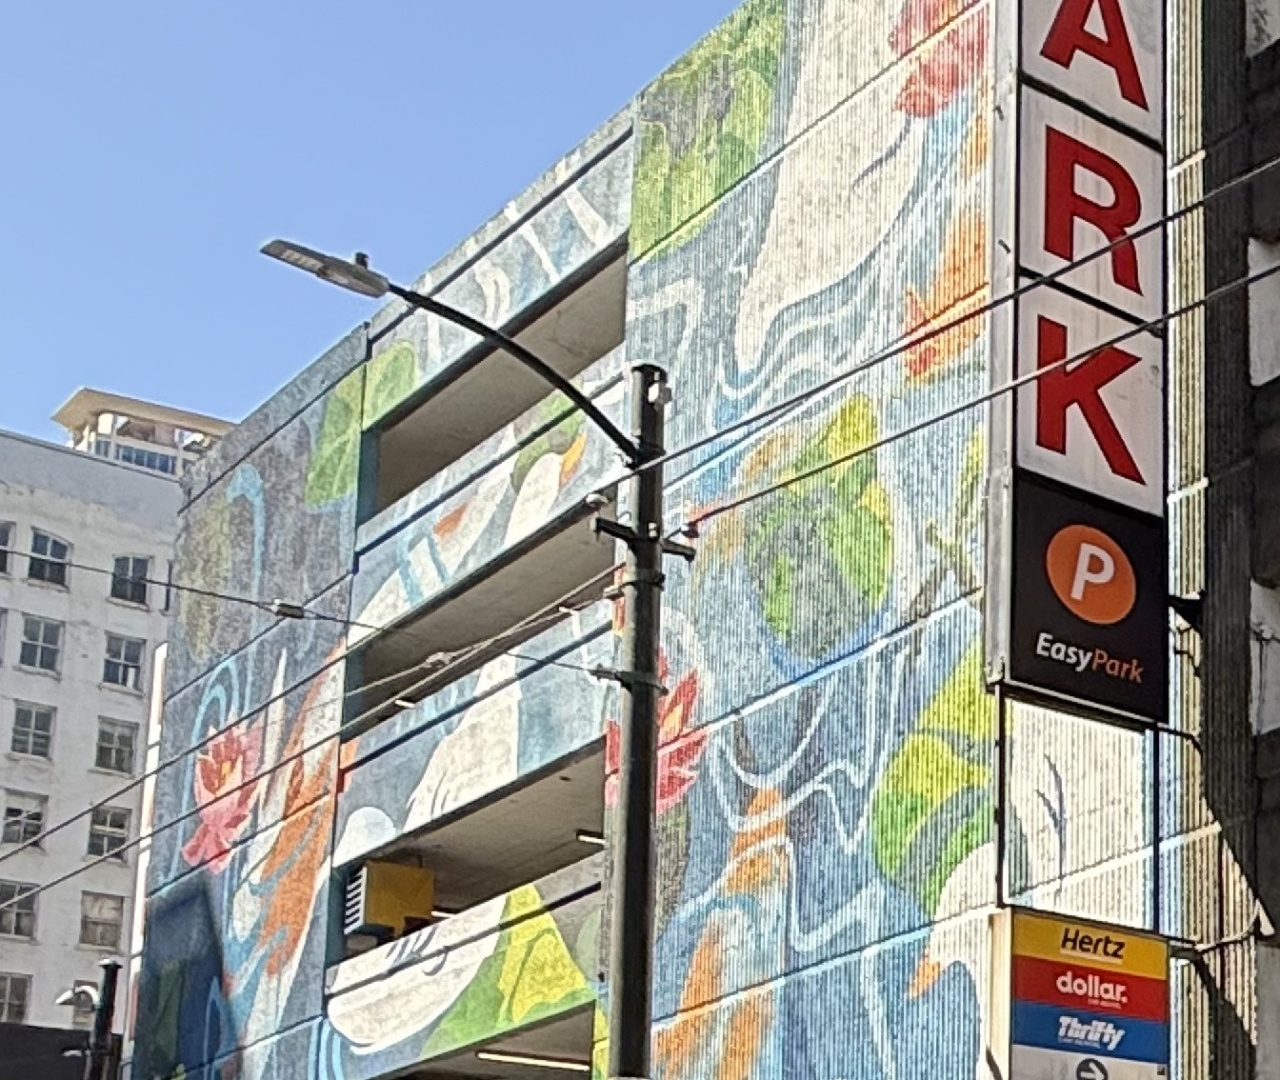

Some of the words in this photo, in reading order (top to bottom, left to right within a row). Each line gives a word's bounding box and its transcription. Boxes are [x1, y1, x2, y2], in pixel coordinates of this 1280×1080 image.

[1070, 541, 1115, 602] P
[1036, 632, 1144, 683] EasyPark
[1061, 927, 1126, 959] Hertz
[1058, 1015, 1126, 1051] Thrifty
